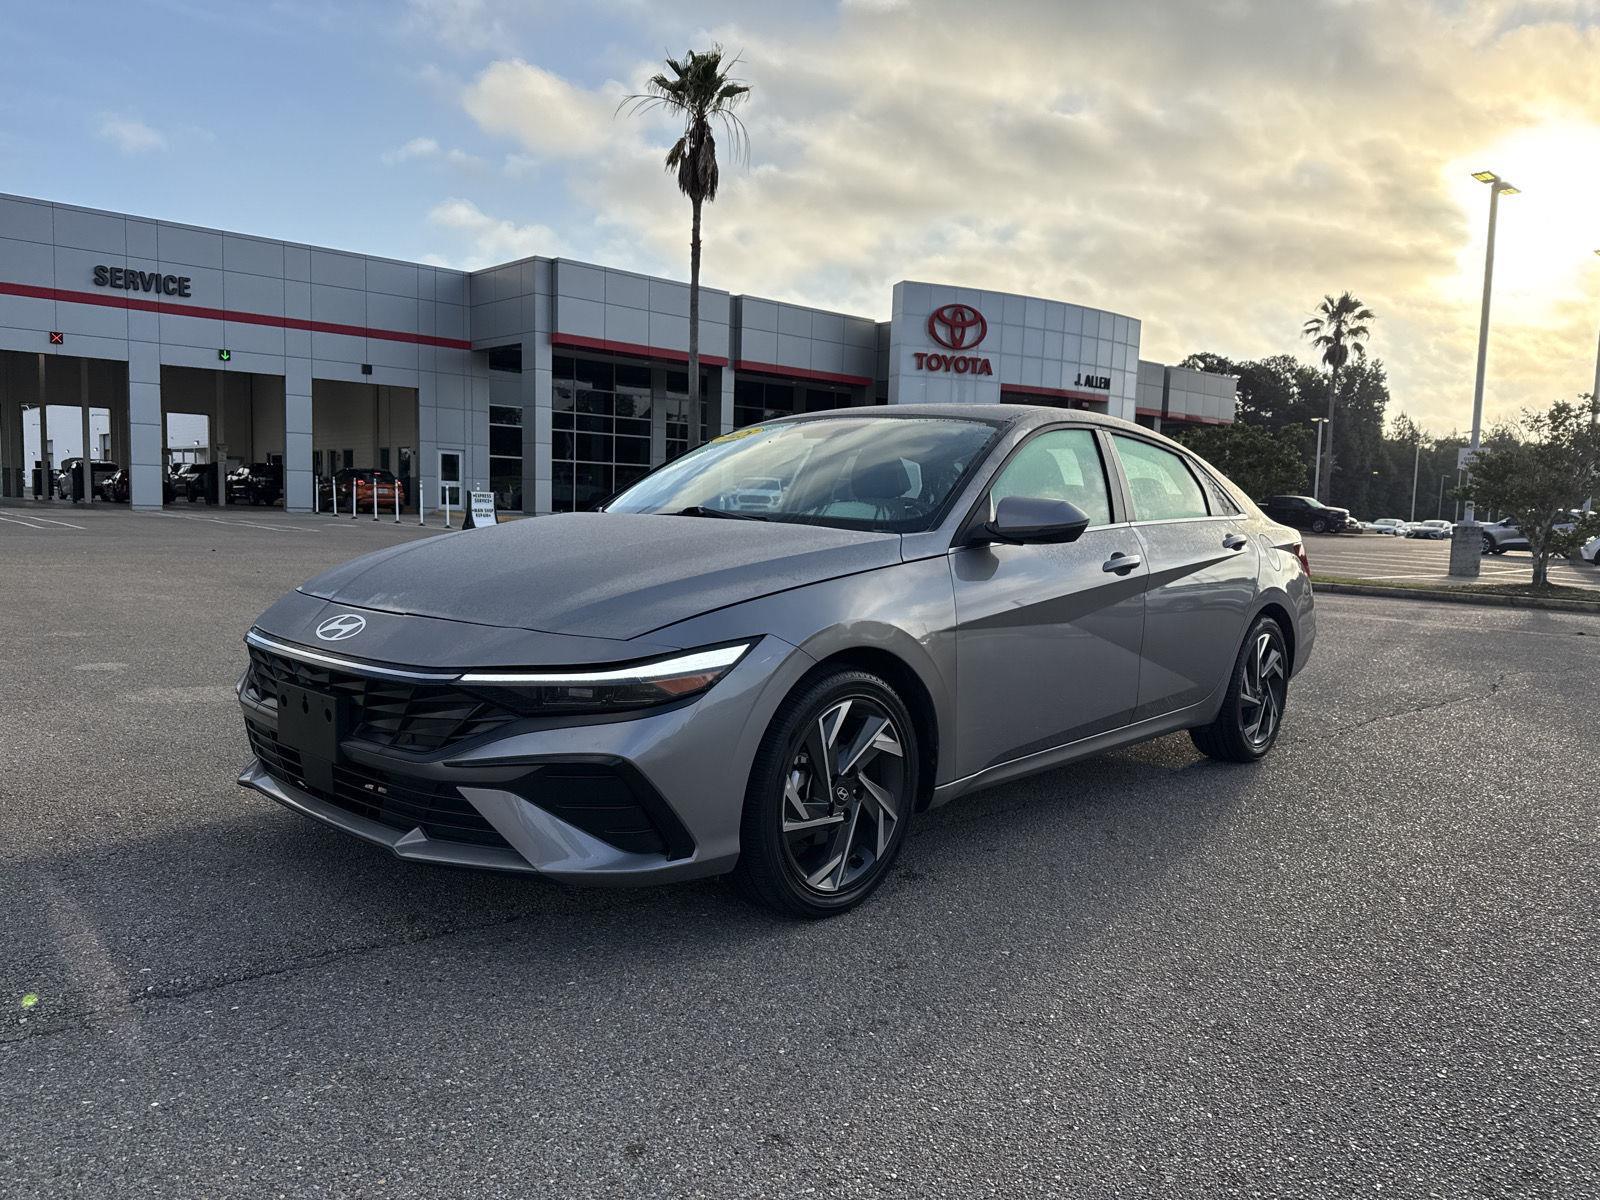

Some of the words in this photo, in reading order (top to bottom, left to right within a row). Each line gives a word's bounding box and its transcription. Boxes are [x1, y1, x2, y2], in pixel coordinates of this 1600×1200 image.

[93, 264, 192, 298] SERVICE
[913, 352, 993, 376] TOYOTA
[1084, 374, 1111, 390] ALLEN
